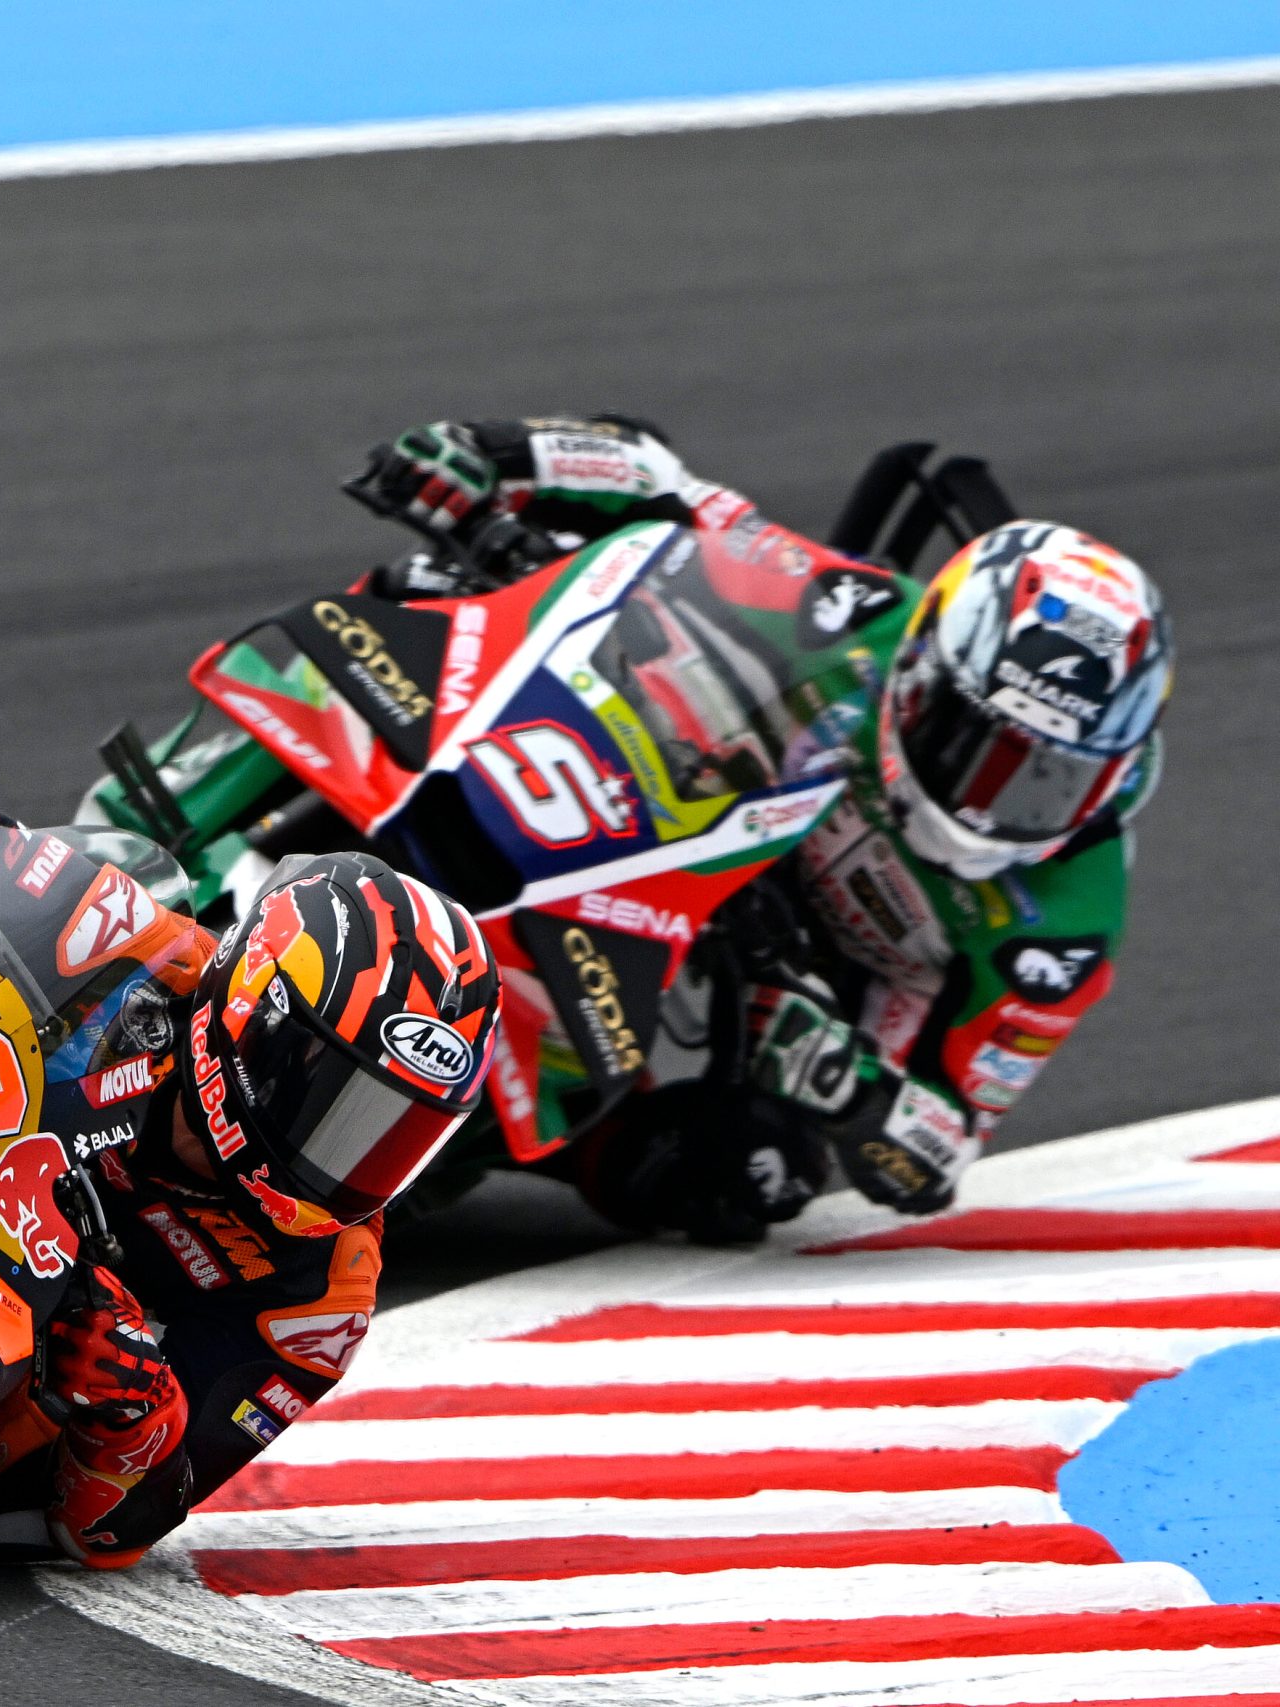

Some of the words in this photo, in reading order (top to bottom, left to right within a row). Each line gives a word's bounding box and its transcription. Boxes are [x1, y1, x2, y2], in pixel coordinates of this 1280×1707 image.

[439, 603, 489, 715] SENA
[995, 659, 1104, 721] SHARK
[459, 719, 639, 849] 5
[23, 836, 70, 890] OTUL
[576, 892, 695, 942] SENA
[229, 996, 250, 1015] 12
[191, 1000, 221, 1085] Red
[387, 1025, 467, 1072] Arai
[100, 1057, 153, 1103] MOTUL
[91, 1123, 134, 1151] BAJAJ
[199, 1072, 247, 1161] Bull
[144, 1210, 221, 1290] MOTUL
[181, 1207, 276, 1282] KTM
[2, 1295, 23, 1316] RACE
